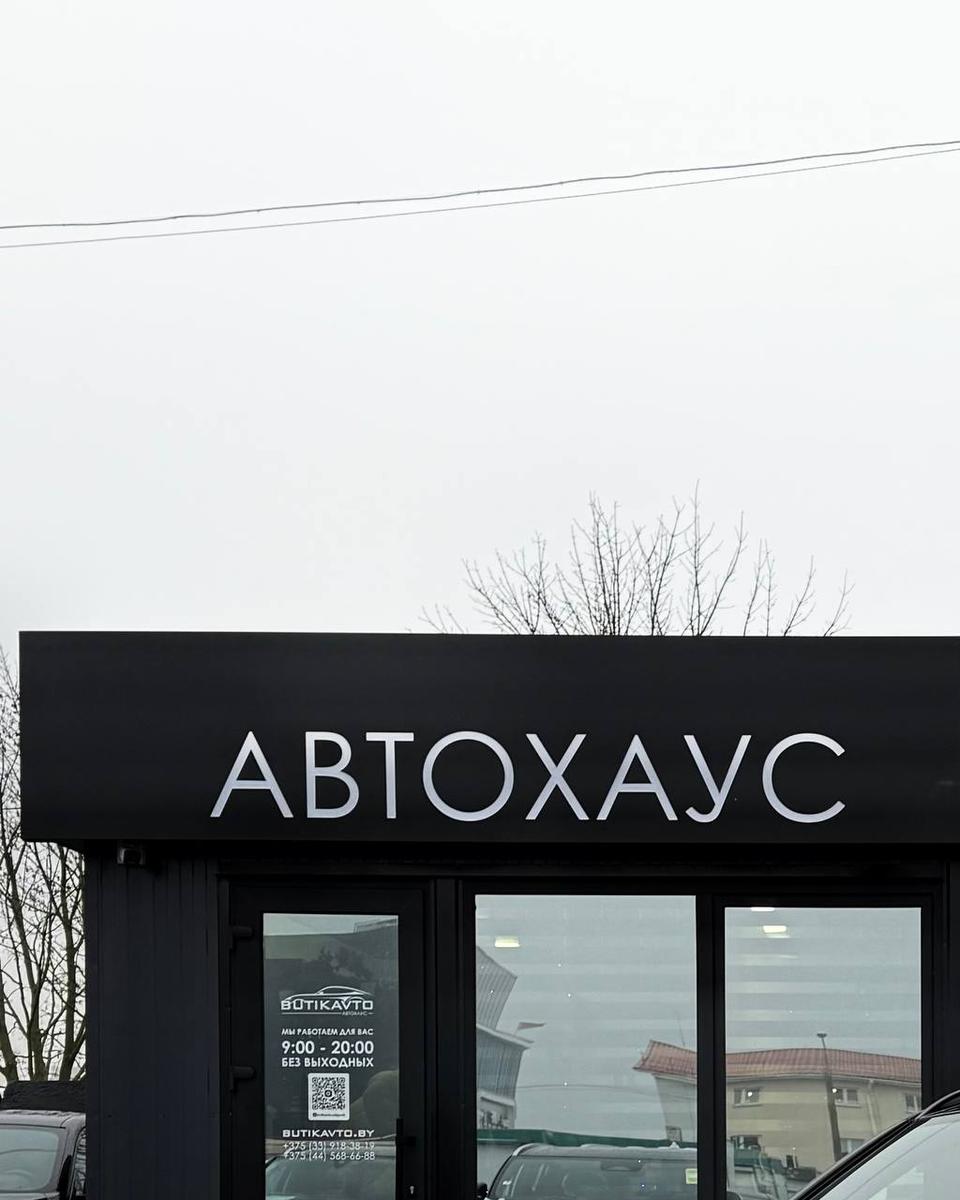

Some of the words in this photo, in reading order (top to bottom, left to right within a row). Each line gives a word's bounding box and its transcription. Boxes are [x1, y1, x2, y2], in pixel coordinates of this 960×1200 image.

[211, 731, 846, 824] АВТОХАУС
[281, 1000, 373, 1011] BUTIKAVTO
[281, 1028, 296, 1036] МЫ
[297, 1028, 338, 1037] РАБОТАЕМ
[339, 1028, 356, 1037] ДЛЯ
[357, 1028, 374, 1036] ВАС
[282, 1041, 315, 1055] 9:00
[331, 1041, 375, 1055] 20:00
[281, 1057, 301, 1068] БЕЗ
[304, 1057, 374, 1068] ВЫХОДНЫХ
[282, 1129, 375, 1138] BUTIKAVTO.BY
